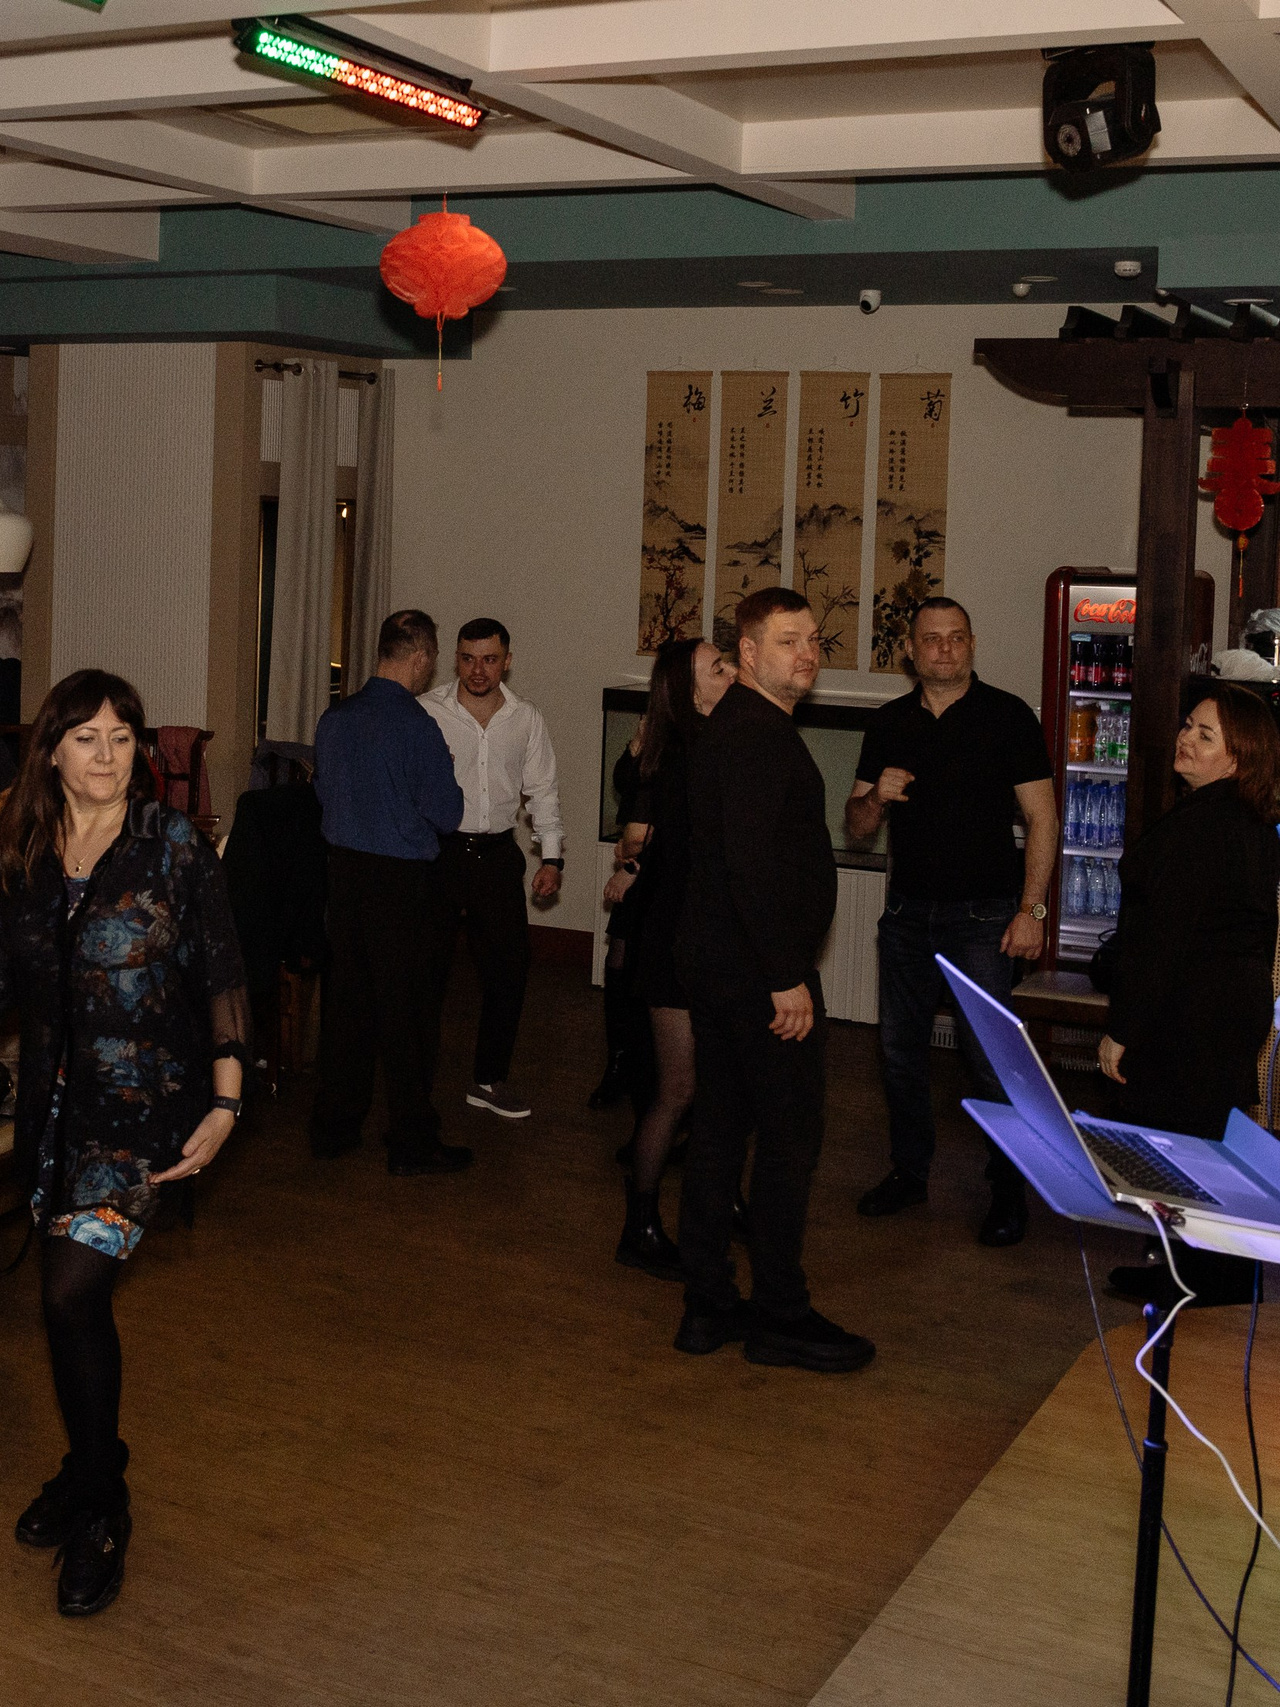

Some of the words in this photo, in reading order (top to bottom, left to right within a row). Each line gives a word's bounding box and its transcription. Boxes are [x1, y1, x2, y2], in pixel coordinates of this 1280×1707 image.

[683, 384, 706, 414] 梅
[840, 388, 865, 419] 竹
[920, 389, 945, 422] 菊
[1074, 598, 1136, 624] Coca-Col
